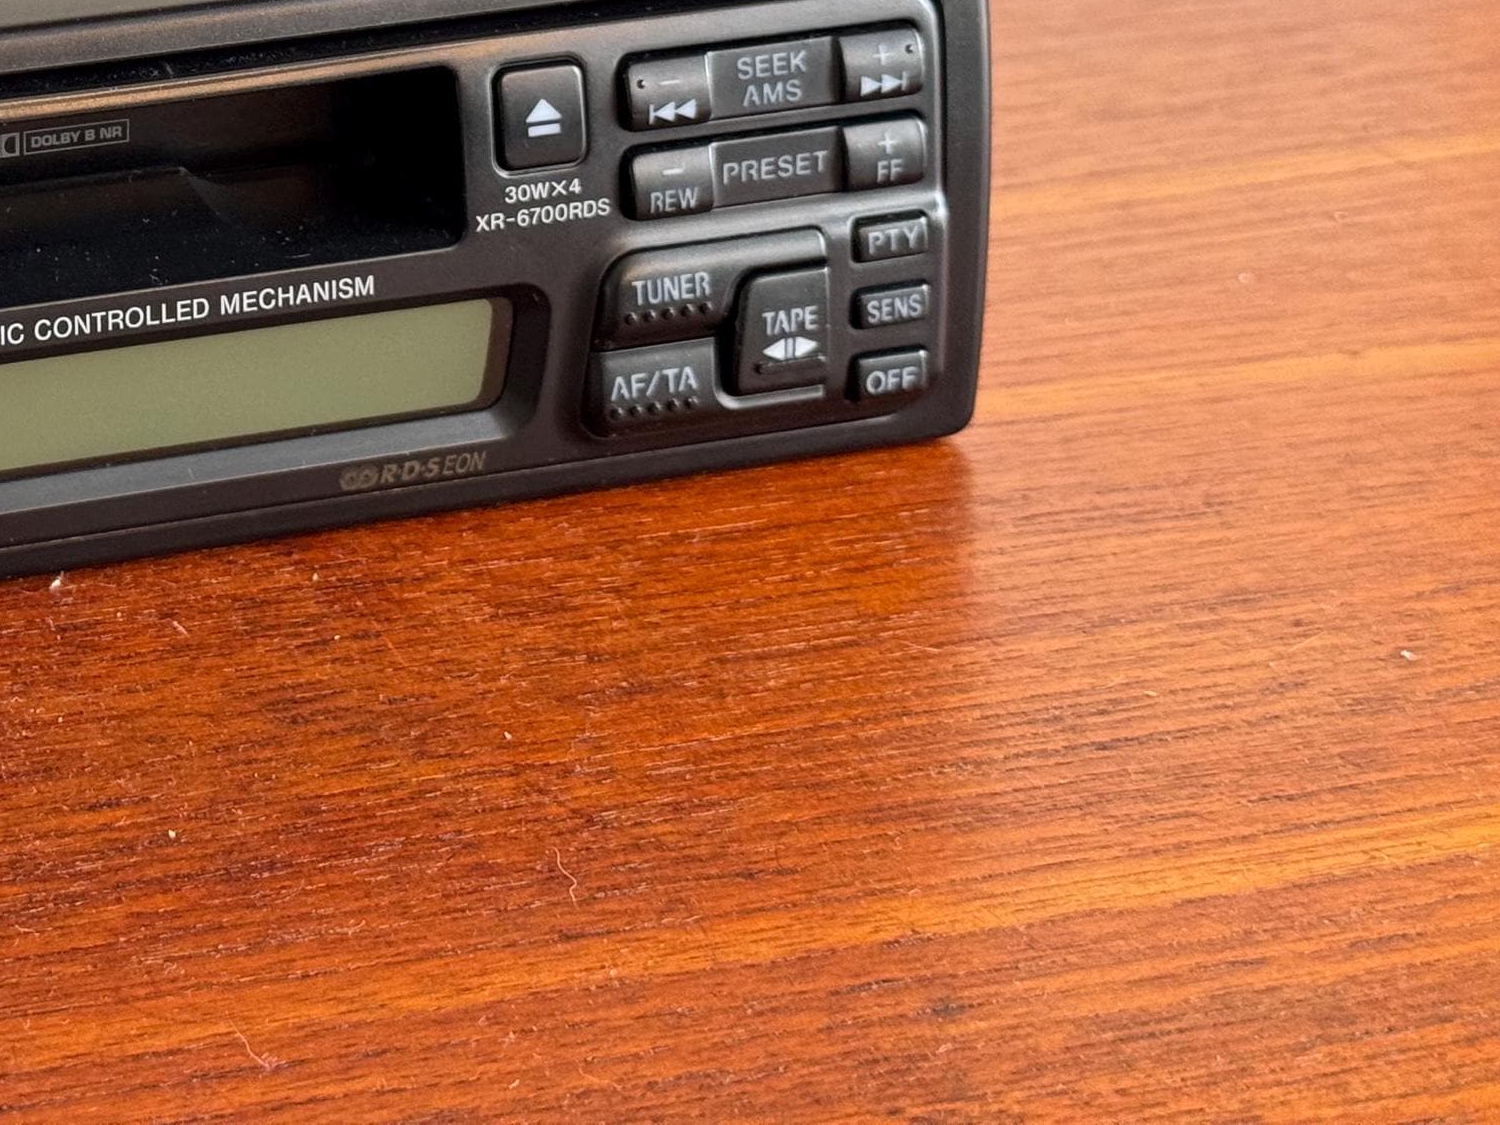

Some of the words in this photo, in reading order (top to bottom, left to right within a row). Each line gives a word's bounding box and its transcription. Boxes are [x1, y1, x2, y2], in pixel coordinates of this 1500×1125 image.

[736, 50, 807, 80] SEEK
[742, 79, 802, 107] AMS
[30, 130, 81, 149] DOLBY
[84, 128, 96, 142] B
[100, 125, 123, 140] NR
[722, 149, 828, 184] PRESET
[876, 159, 904, 182] FF
[475, 197, 612, 233] XR-6700RDS
[650, 186, 699, 214] REW
[867, 225, 922, 252] PTY
[631, 271, 713, 306] TUNER
[33, 297, 210, 342] CONTROLLED
[220, 274, 376, 316] MECHANISM
[761, 305, 819, 336] TAPE
[866, 293, 924, 325] SENS
[610, 366, 698, 403] AF/TA
[865, 367, 917, 397] OFF
[442, 450, 487, 475] EON
